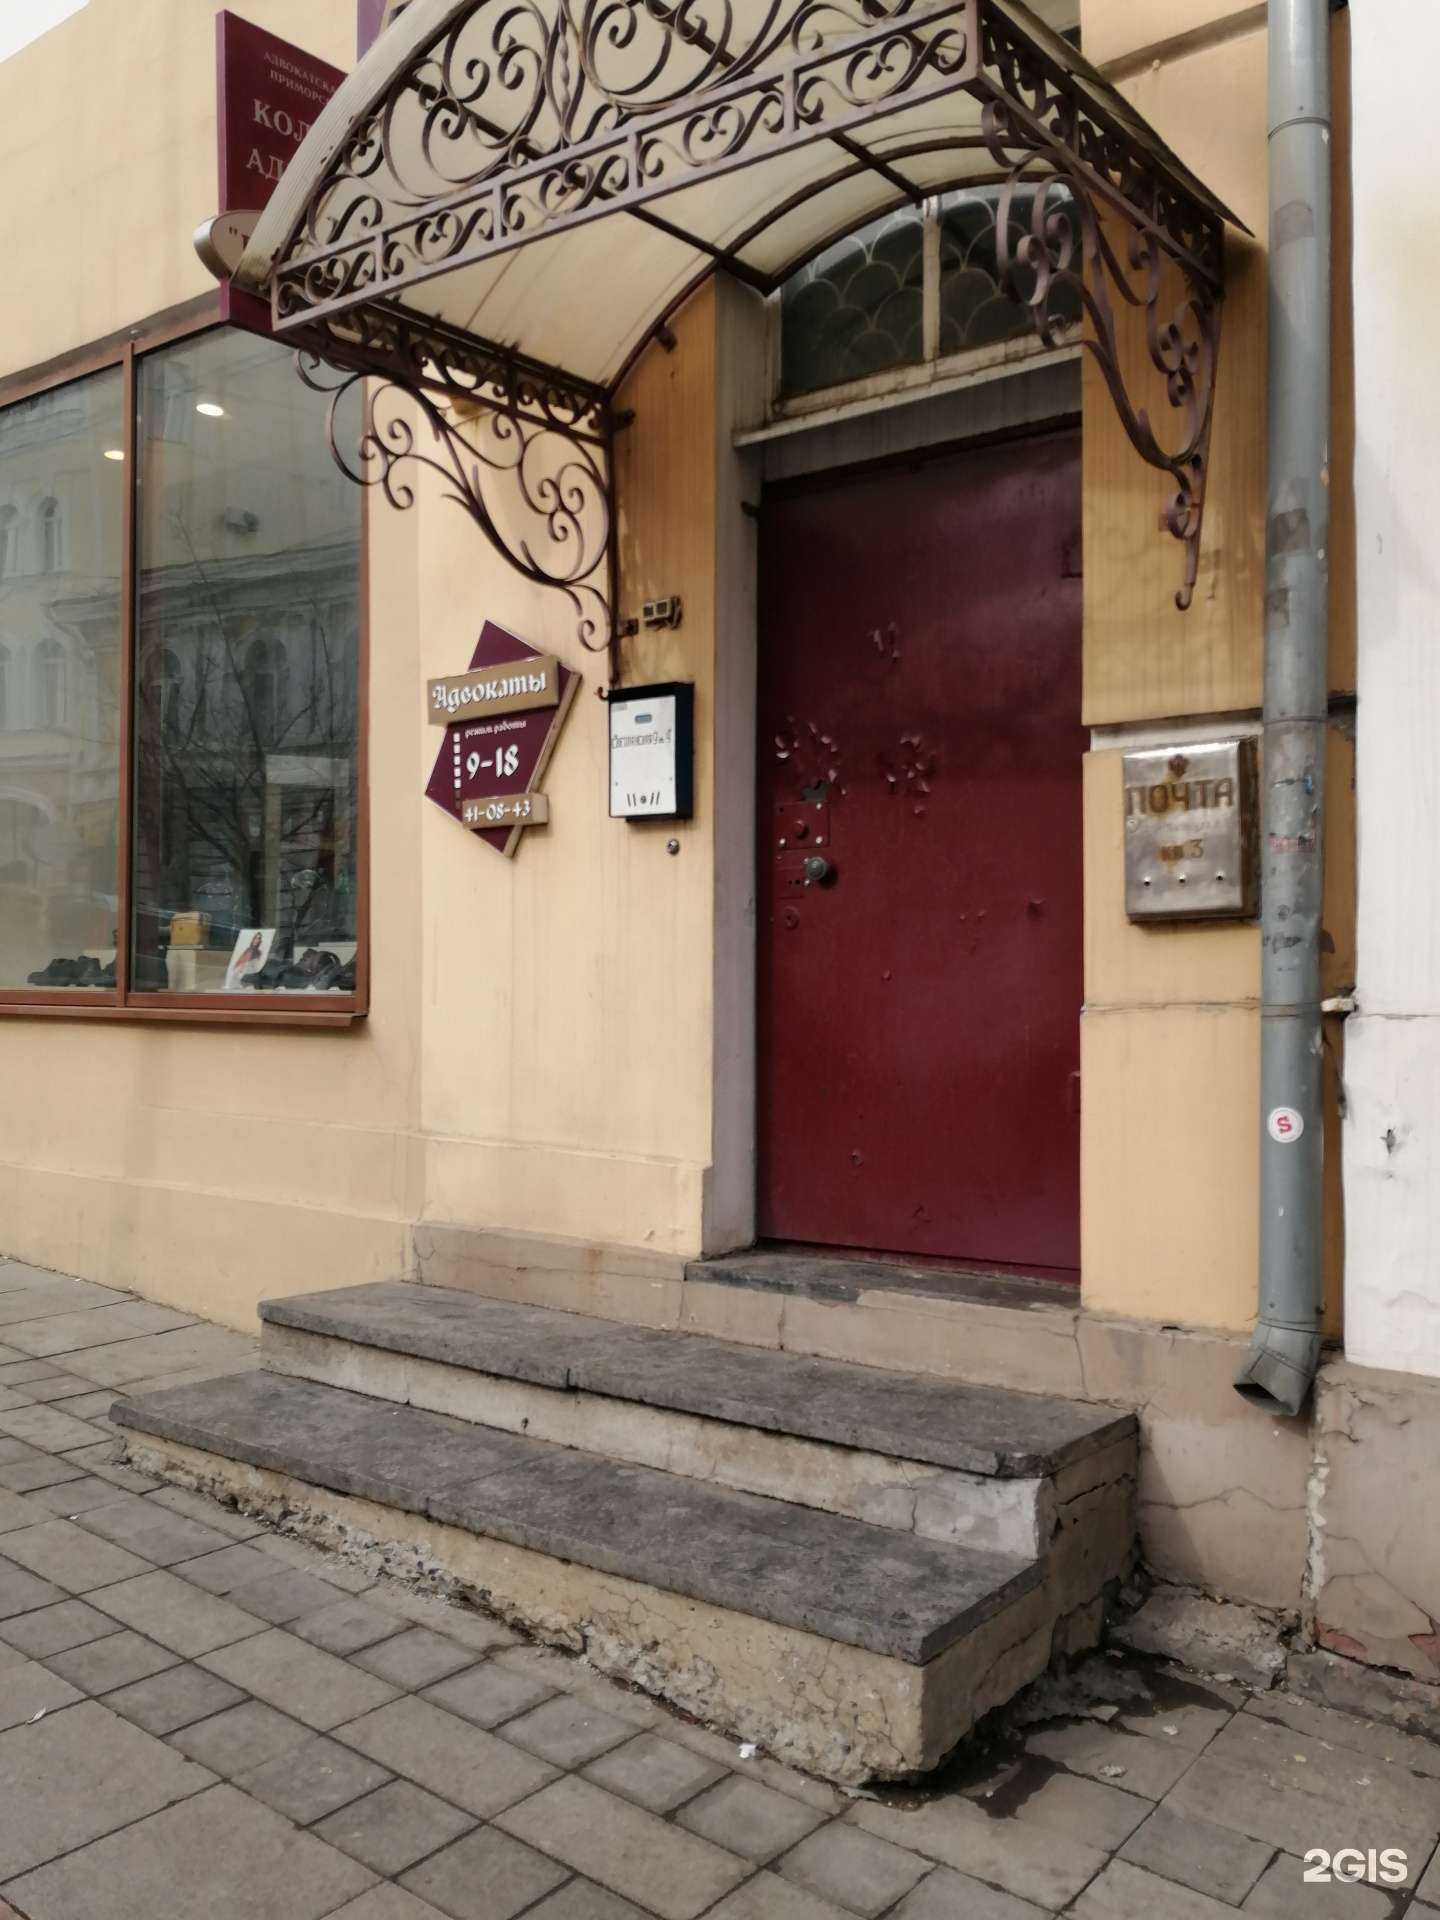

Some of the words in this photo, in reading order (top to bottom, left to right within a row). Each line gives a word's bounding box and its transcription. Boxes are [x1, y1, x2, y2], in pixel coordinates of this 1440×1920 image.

[270, 69, 330, 106] ПРИМОРС
[432, 672, 547, 714] Адвокаты
[466, 744, 519, 780] 9-18
[465, 800, 531, 822] 41-08-43
[1125, 777, 1233, 817] ПОЧТА
